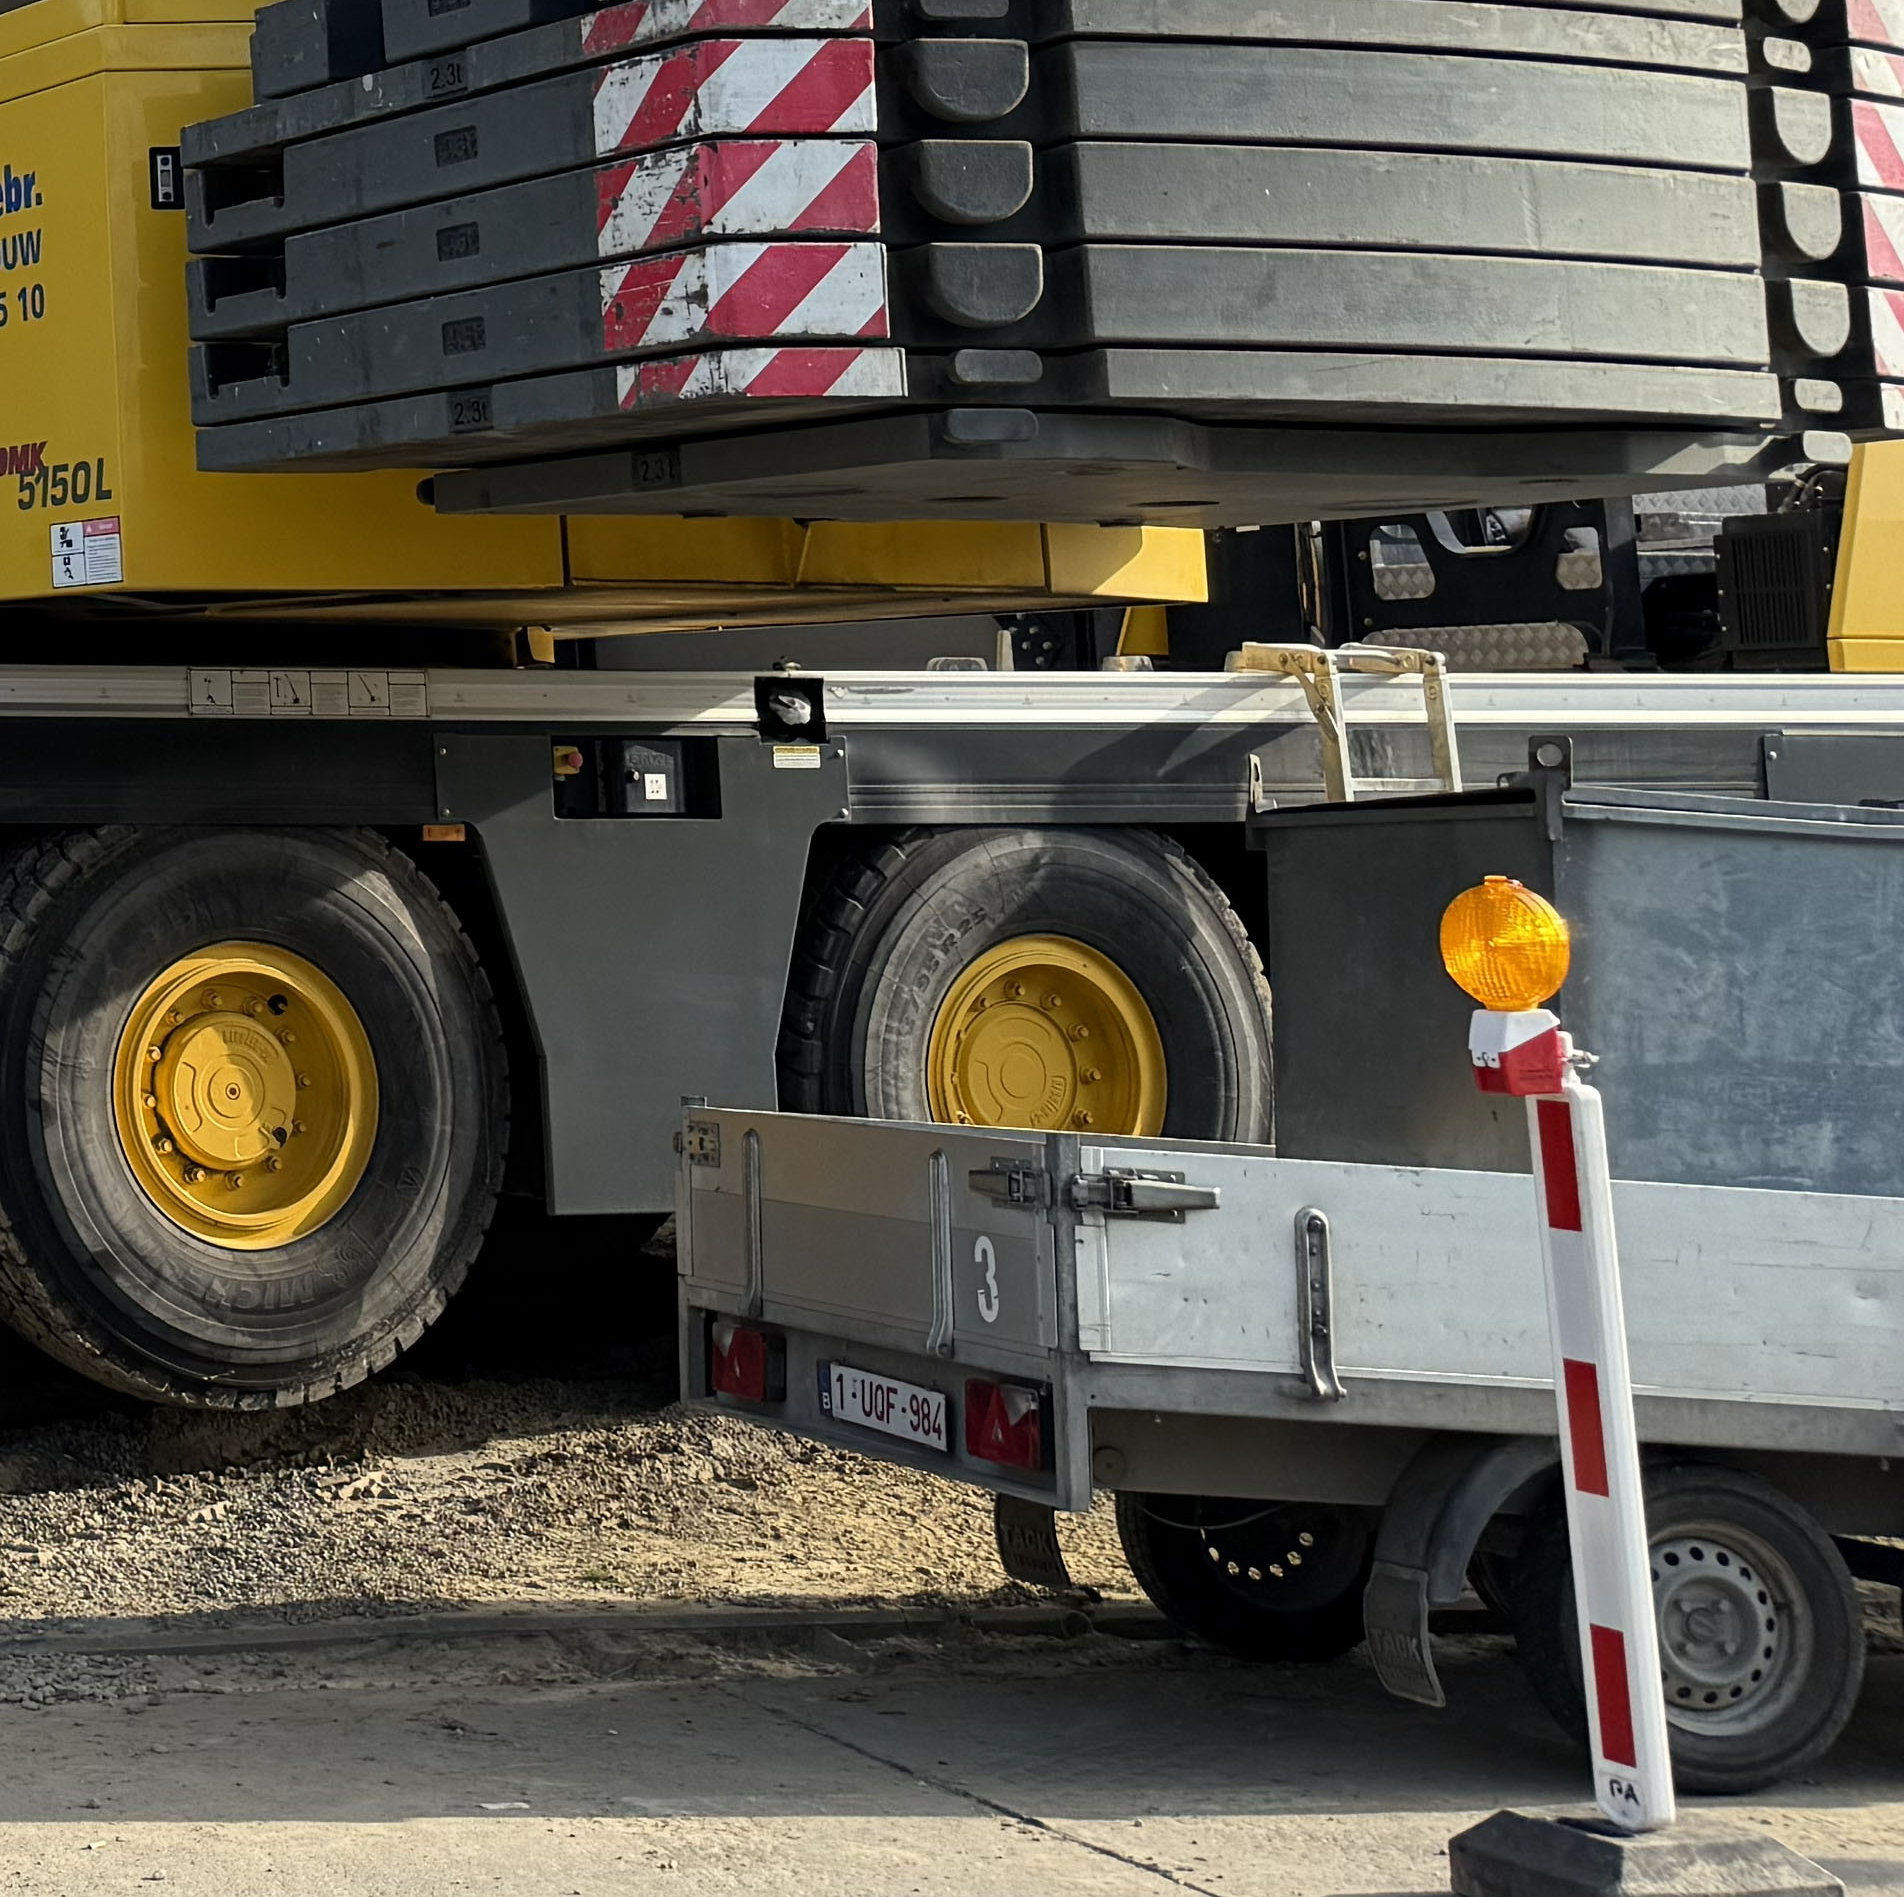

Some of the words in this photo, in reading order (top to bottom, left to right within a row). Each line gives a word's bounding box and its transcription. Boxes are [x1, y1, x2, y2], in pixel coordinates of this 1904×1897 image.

[17, 283, 46, 321] 10
[974, 1235, 999, 1323] 3
[822, 1392, 830, 1409] B
[836, 1373, 942, 1441] 1-UQF-984
